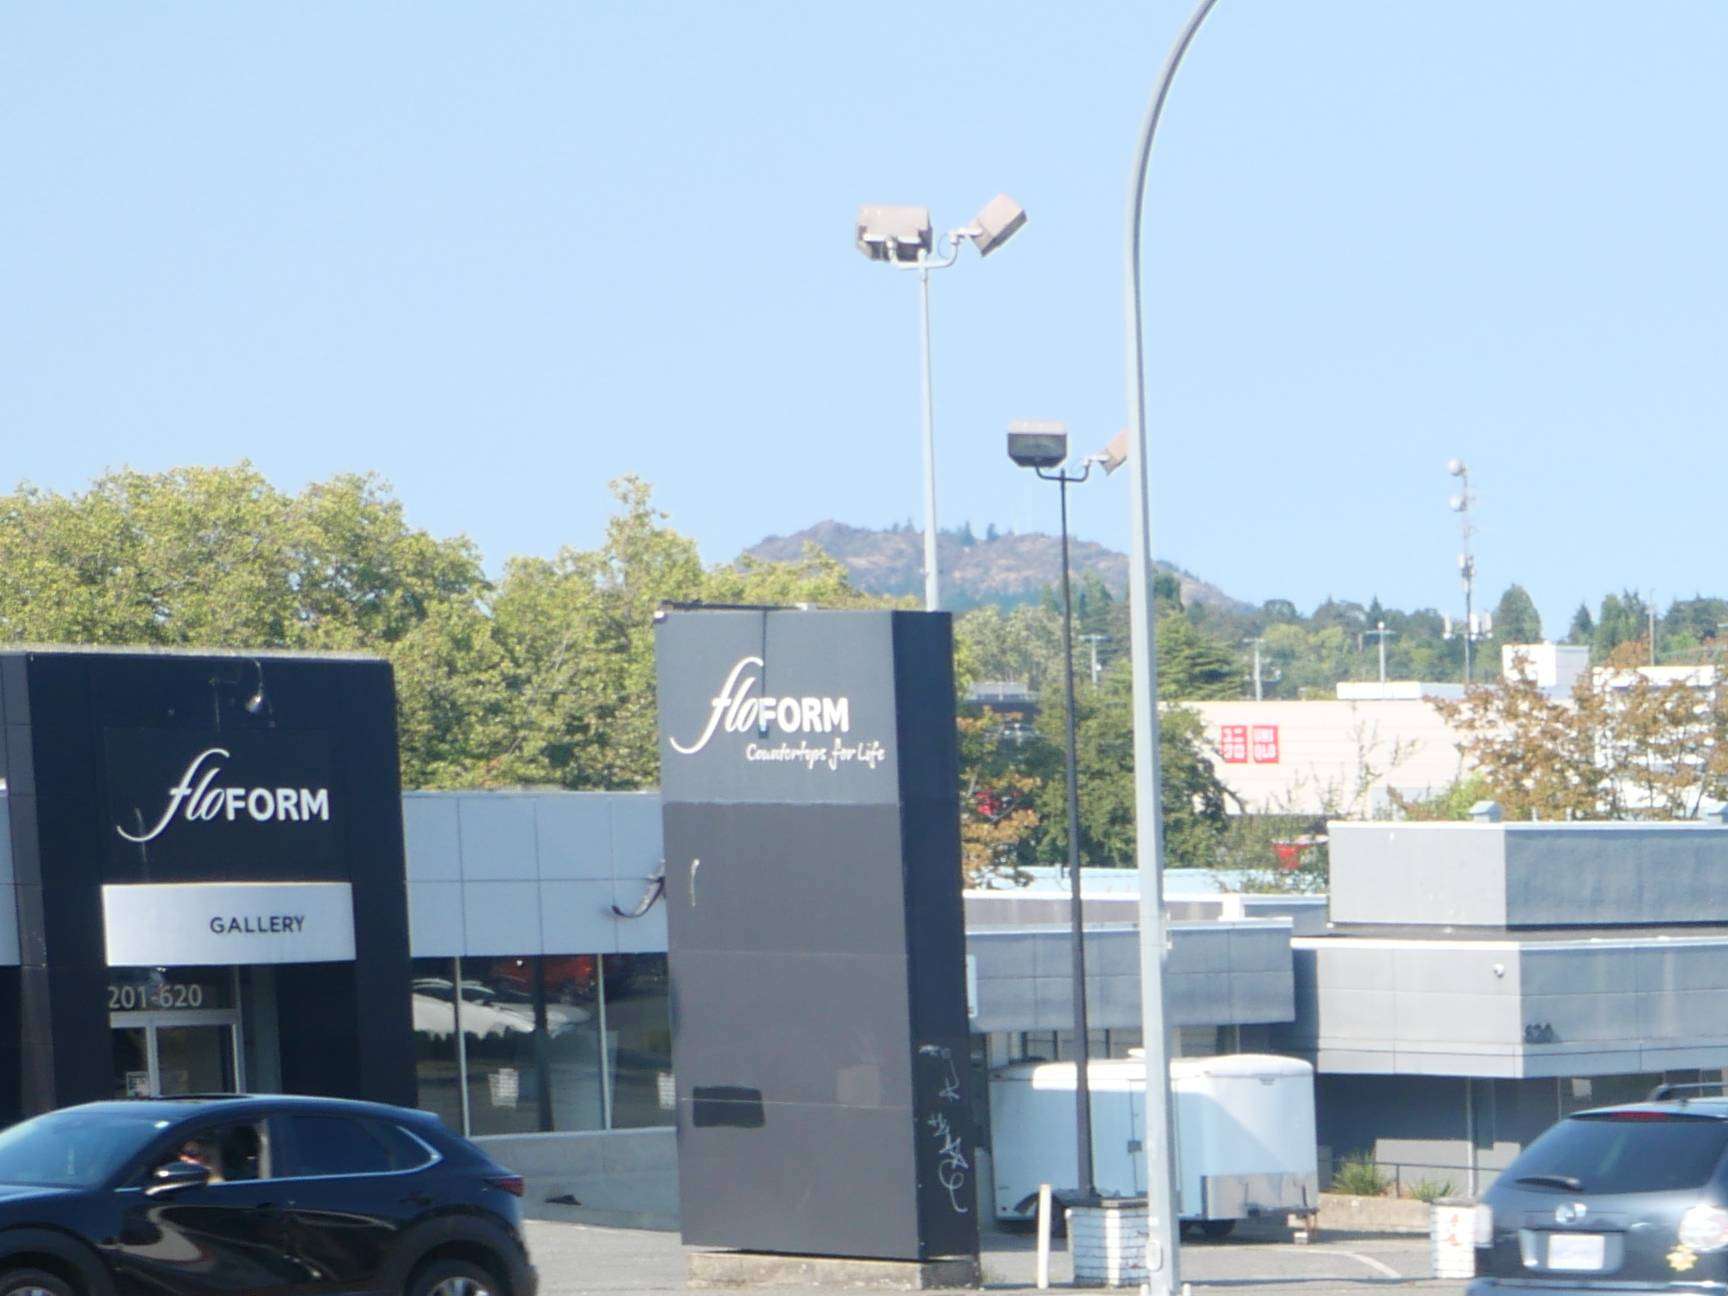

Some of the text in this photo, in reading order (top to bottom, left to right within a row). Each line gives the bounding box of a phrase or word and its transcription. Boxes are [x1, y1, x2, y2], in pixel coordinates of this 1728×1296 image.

[745, 737, 885, 770] Countertops for Life
[210, 915, 304, 934] GALLERY
